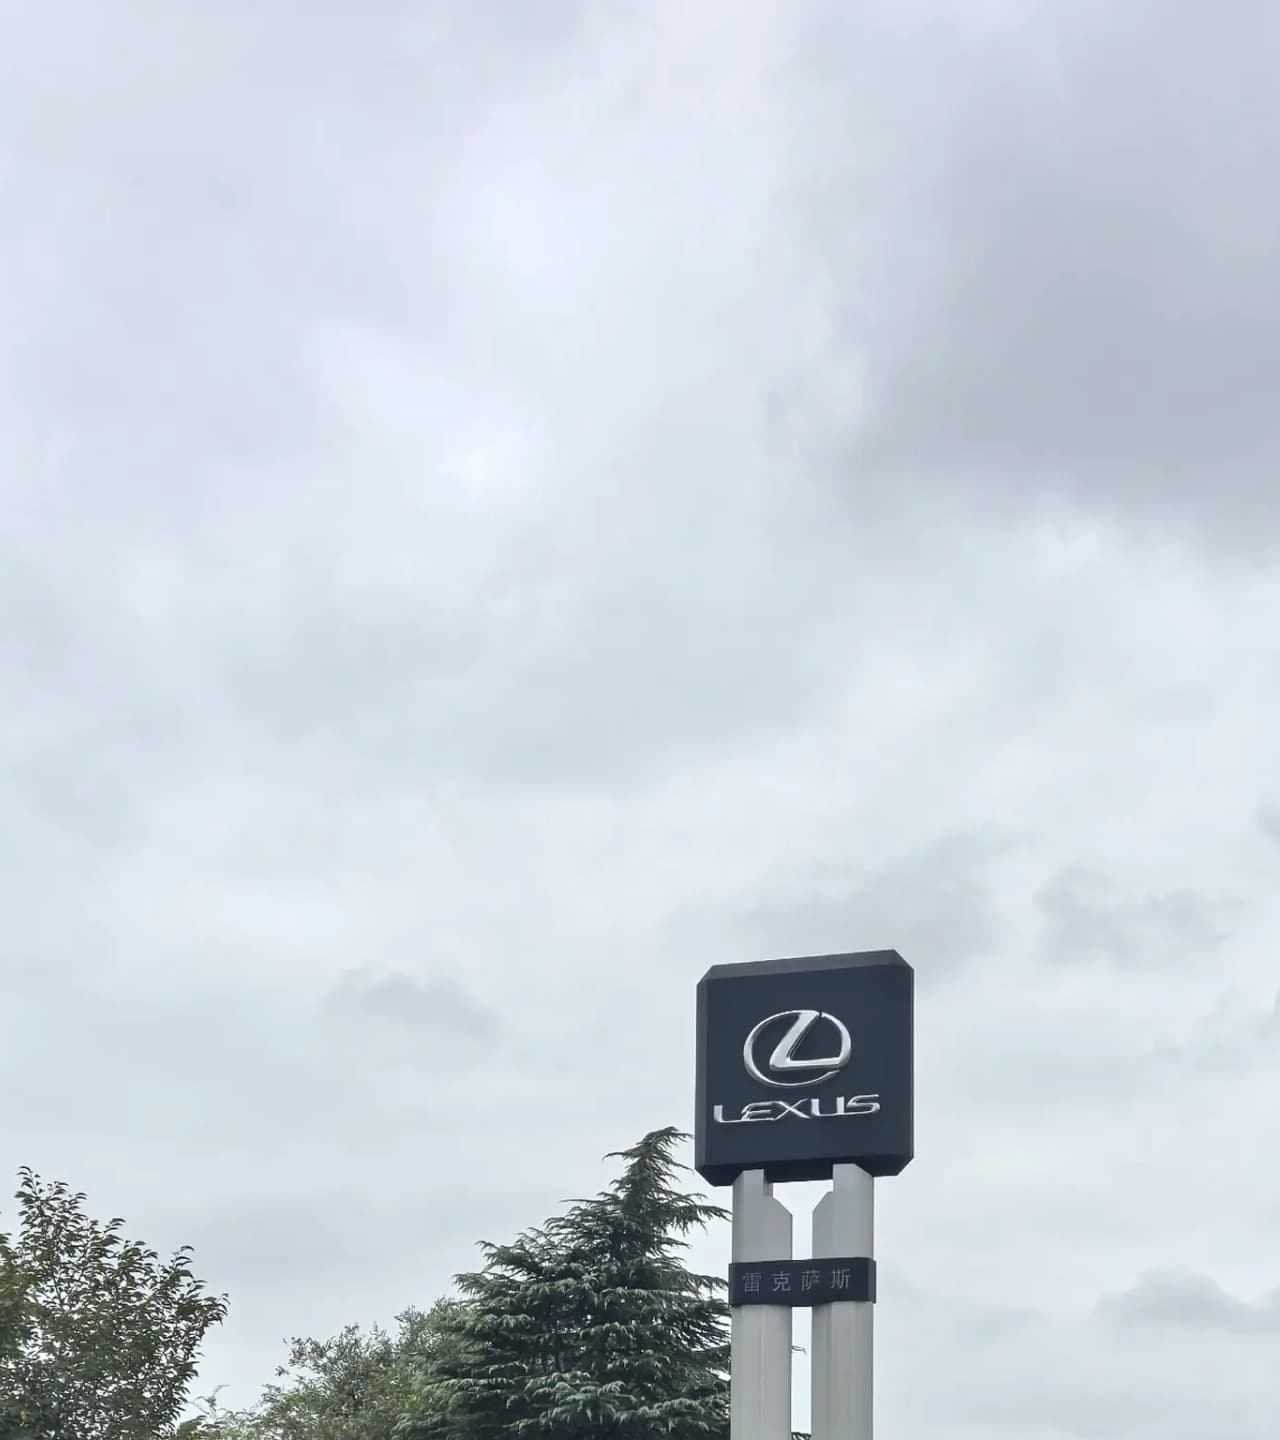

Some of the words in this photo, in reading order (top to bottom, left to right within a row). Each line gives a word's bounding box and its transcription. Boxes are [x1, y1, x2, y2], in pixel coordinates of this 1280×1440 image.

[713, 1093, 880, 1123] LEXUS
[741, 1267, 852, 1293] 雷克萨斯
